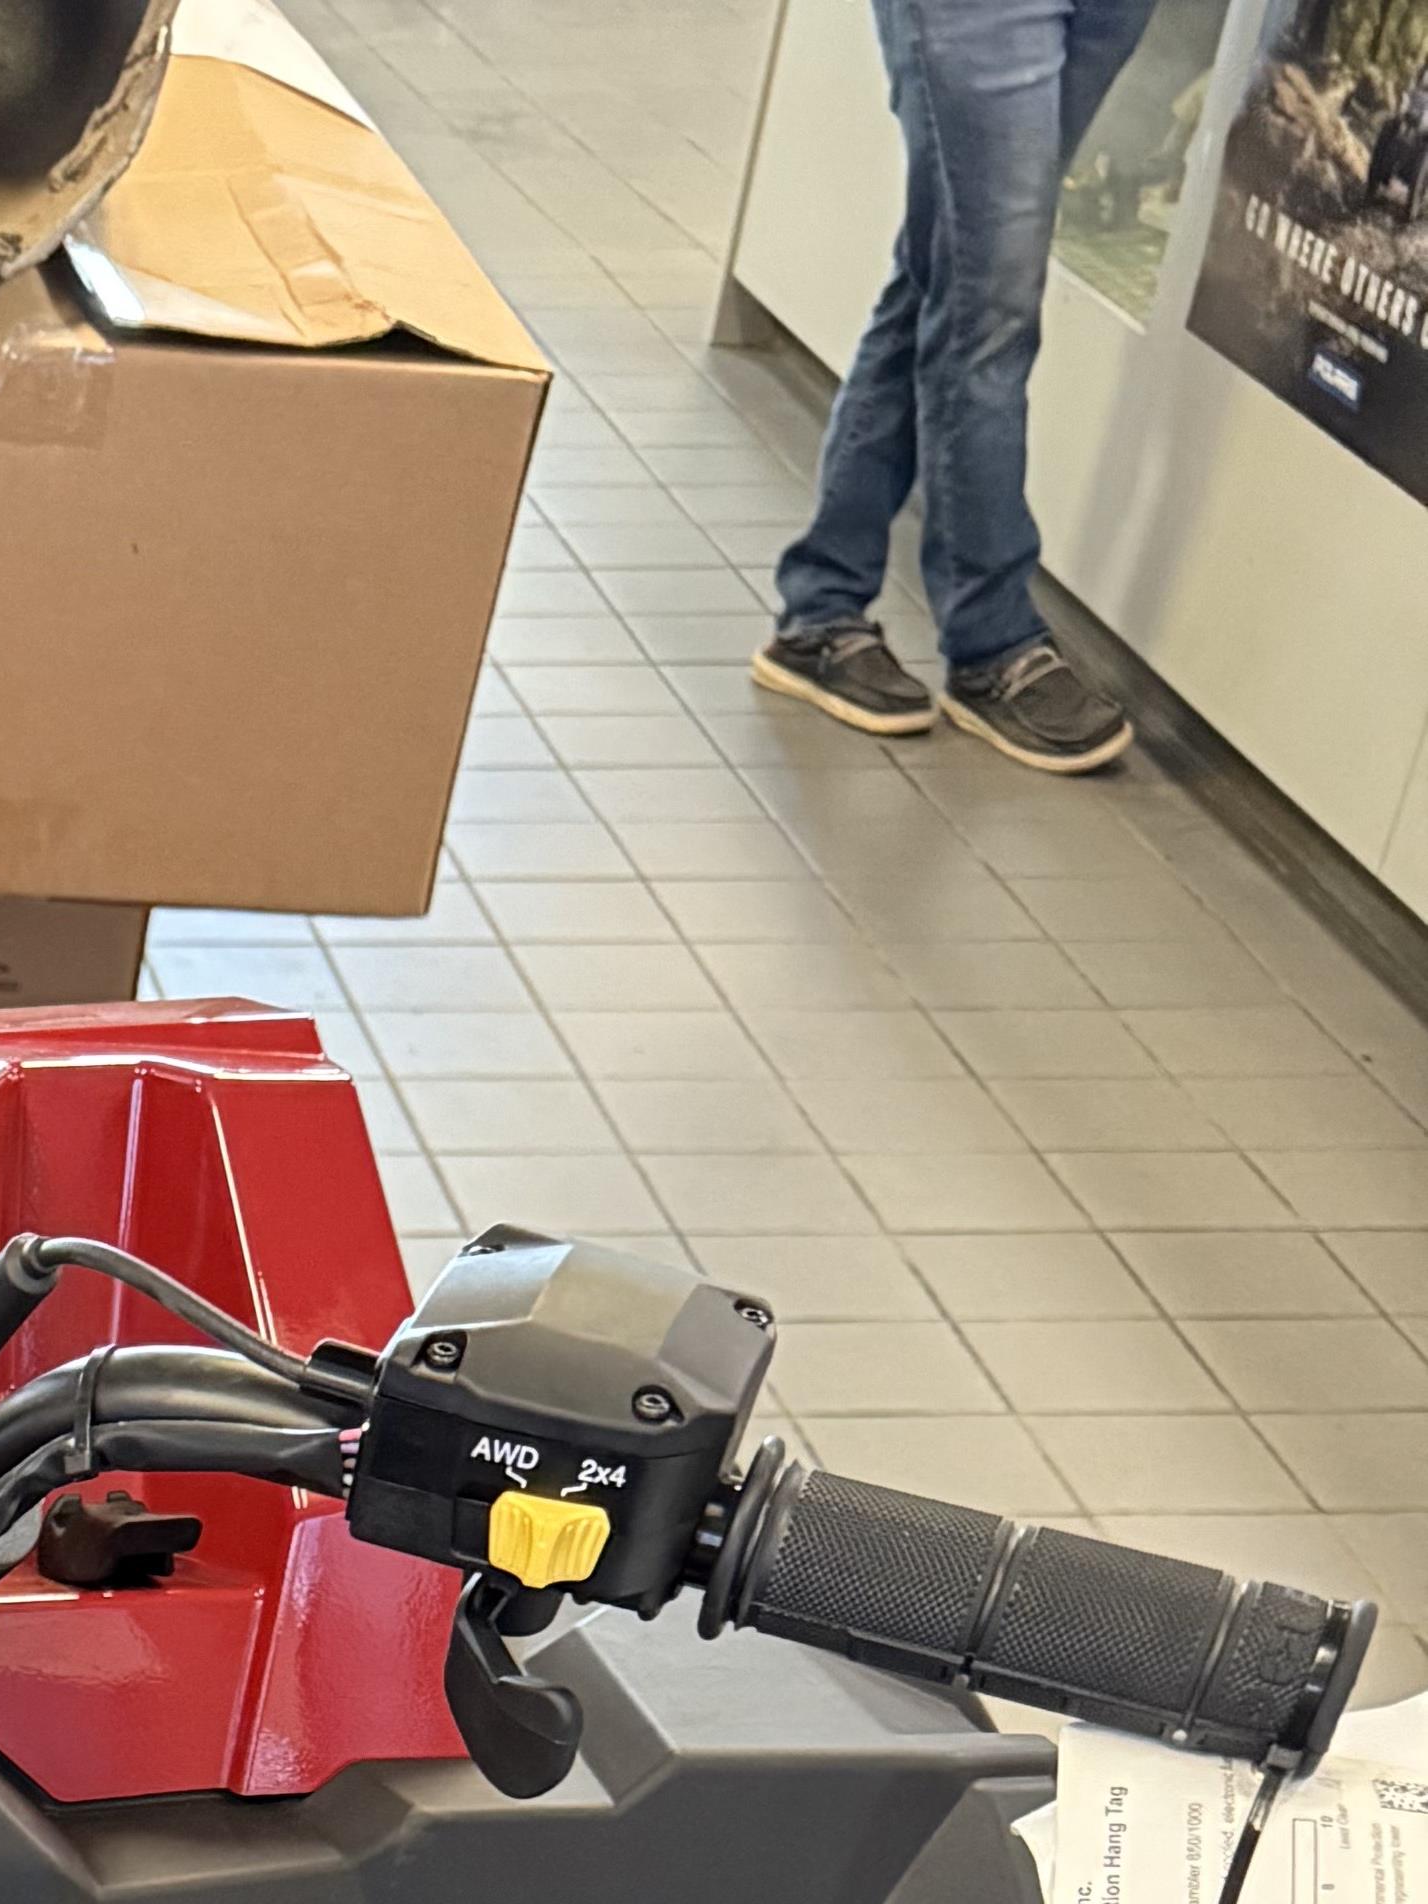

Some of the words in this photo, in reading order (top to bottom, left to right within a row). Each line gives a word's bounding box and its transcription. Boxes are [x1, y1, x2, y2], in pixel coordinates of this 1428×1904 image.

[1274, 212, 1338, 284] WHERE
[1340, 256, 1419, 336] OTHERS
[470, 1436, 539, 1471] AWD
[578, 1459, 626, 1488] 2x4
[1104, 1786, 1128, 1816] Tag
[1186, 1803, 1203, 1860] 850/1000
[1320, 1816, 1334, 1828] 10
[1103, 1823, 1126, 1868] Hang
